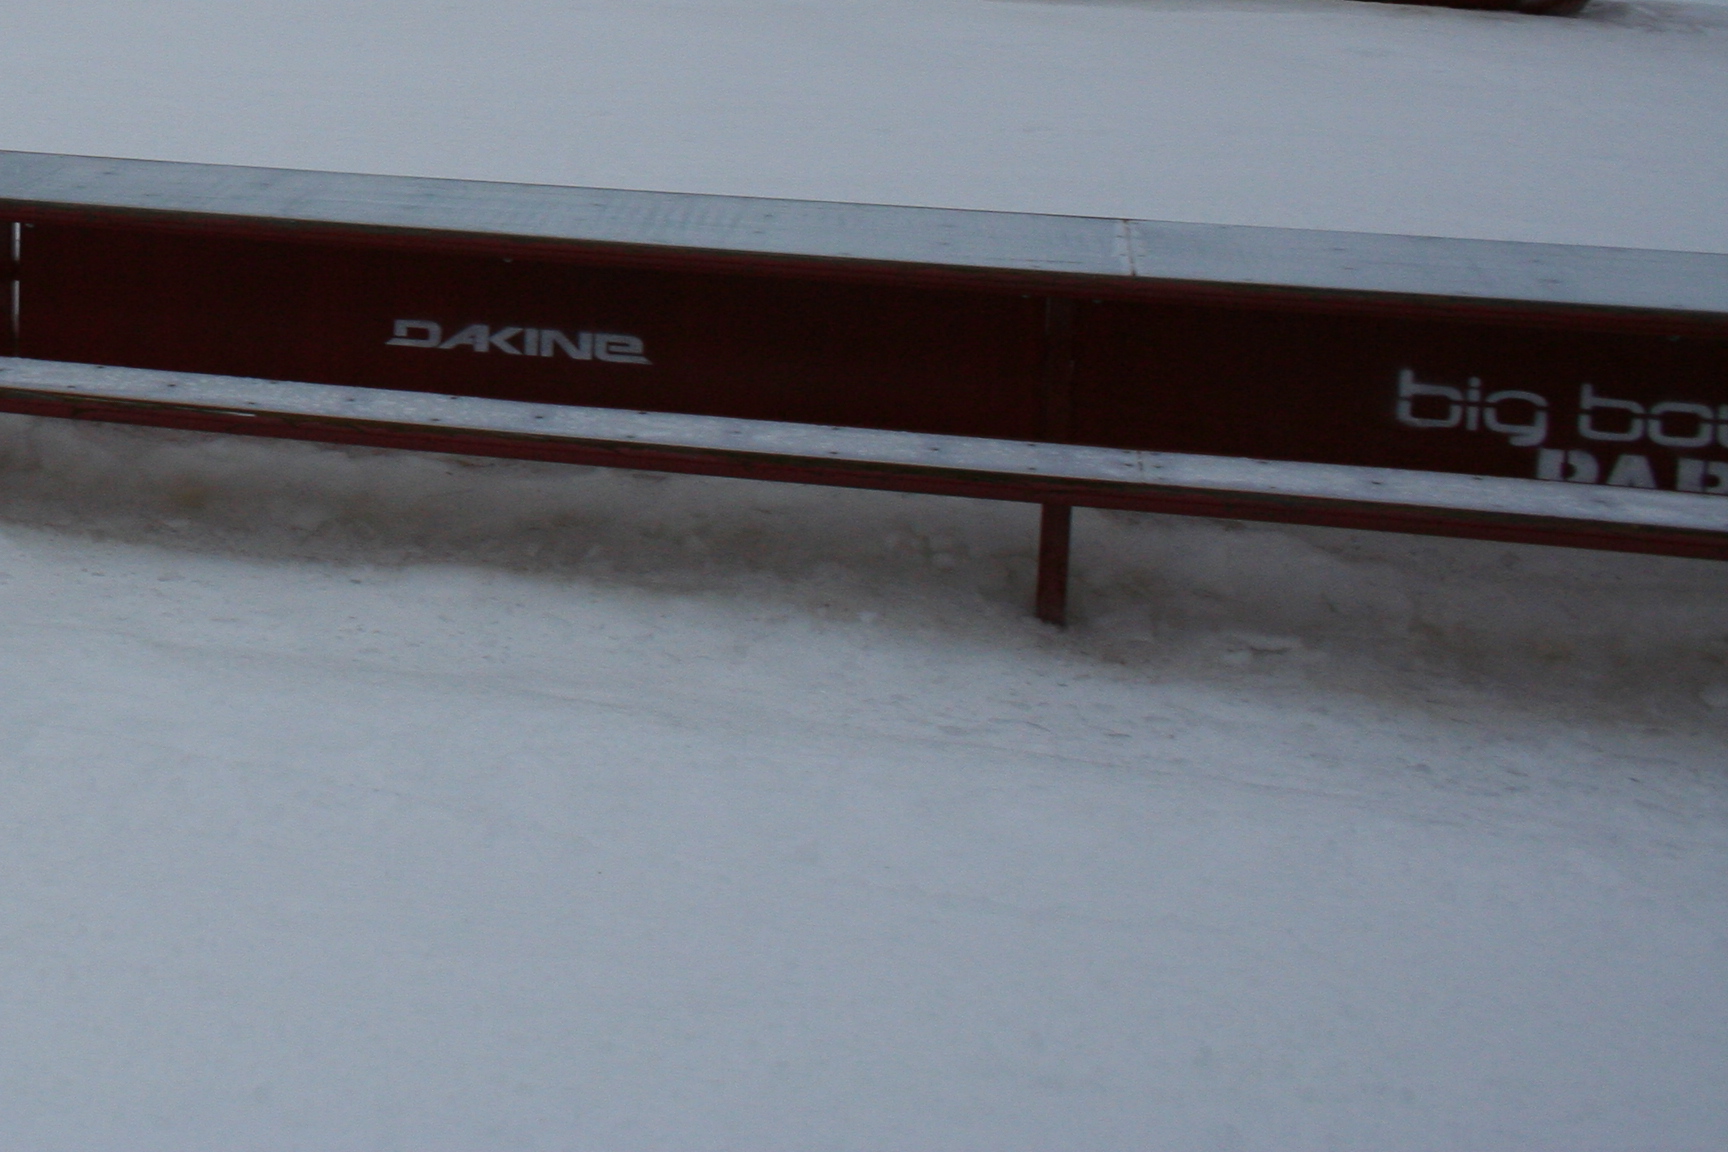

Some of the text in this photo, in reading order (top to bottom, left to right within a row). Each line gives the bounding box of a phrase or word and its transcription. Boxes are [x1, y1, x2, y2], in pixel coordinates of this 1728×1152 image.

[384, 319, 653, 365] DAKINE
[1395, 367, 1728, 449] big bo
